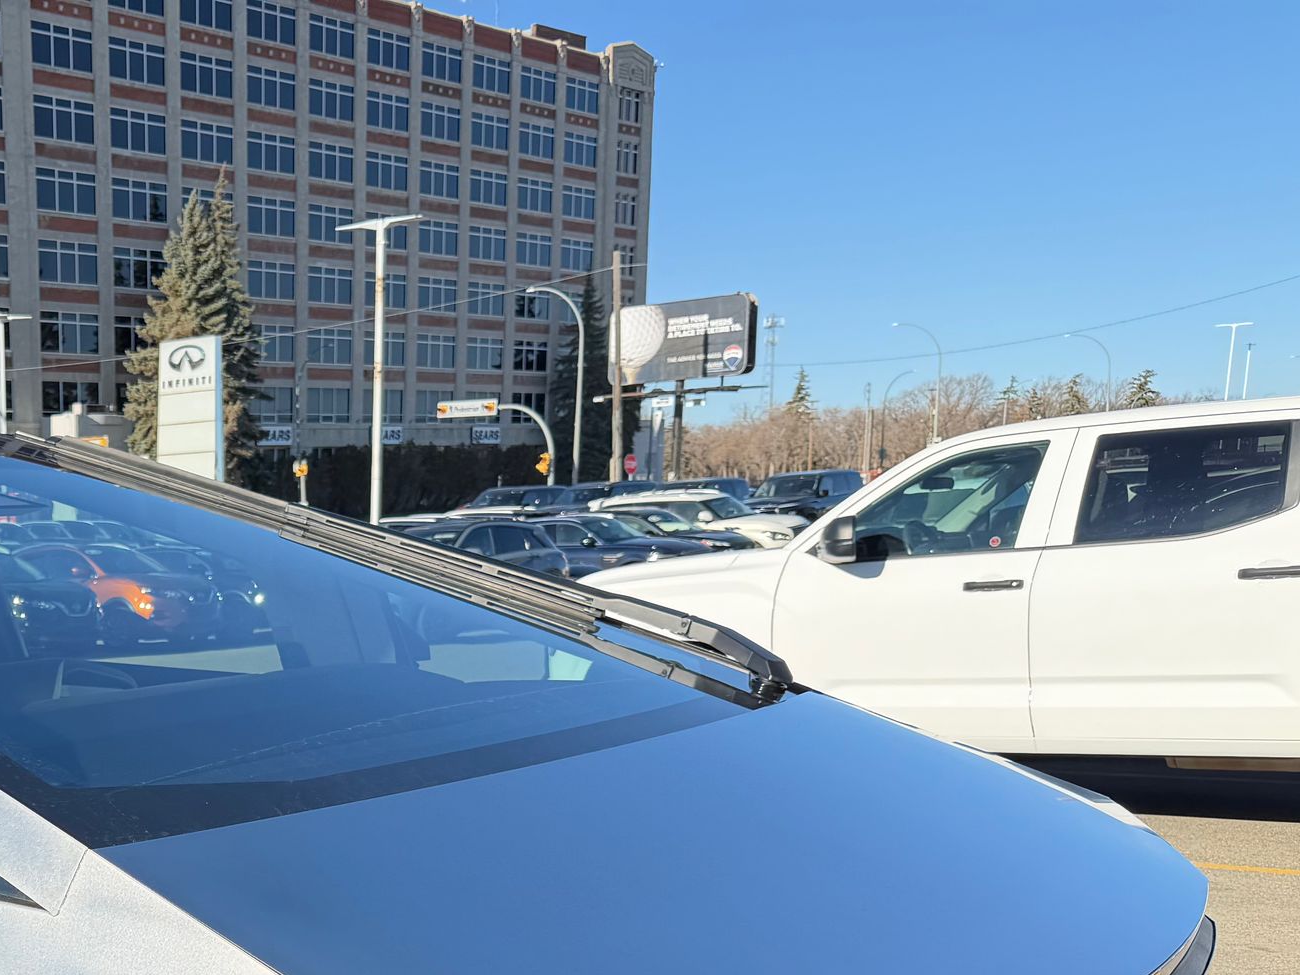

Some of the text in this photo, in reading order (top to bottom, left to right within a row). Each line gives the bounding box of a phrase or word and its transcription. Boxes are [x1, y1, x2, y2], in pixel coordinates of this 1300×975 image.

[162, 376, 212, 389] INFINITI
[382, 430, 401, 441] ARS
[474, 430, 500, 441] SEARS
